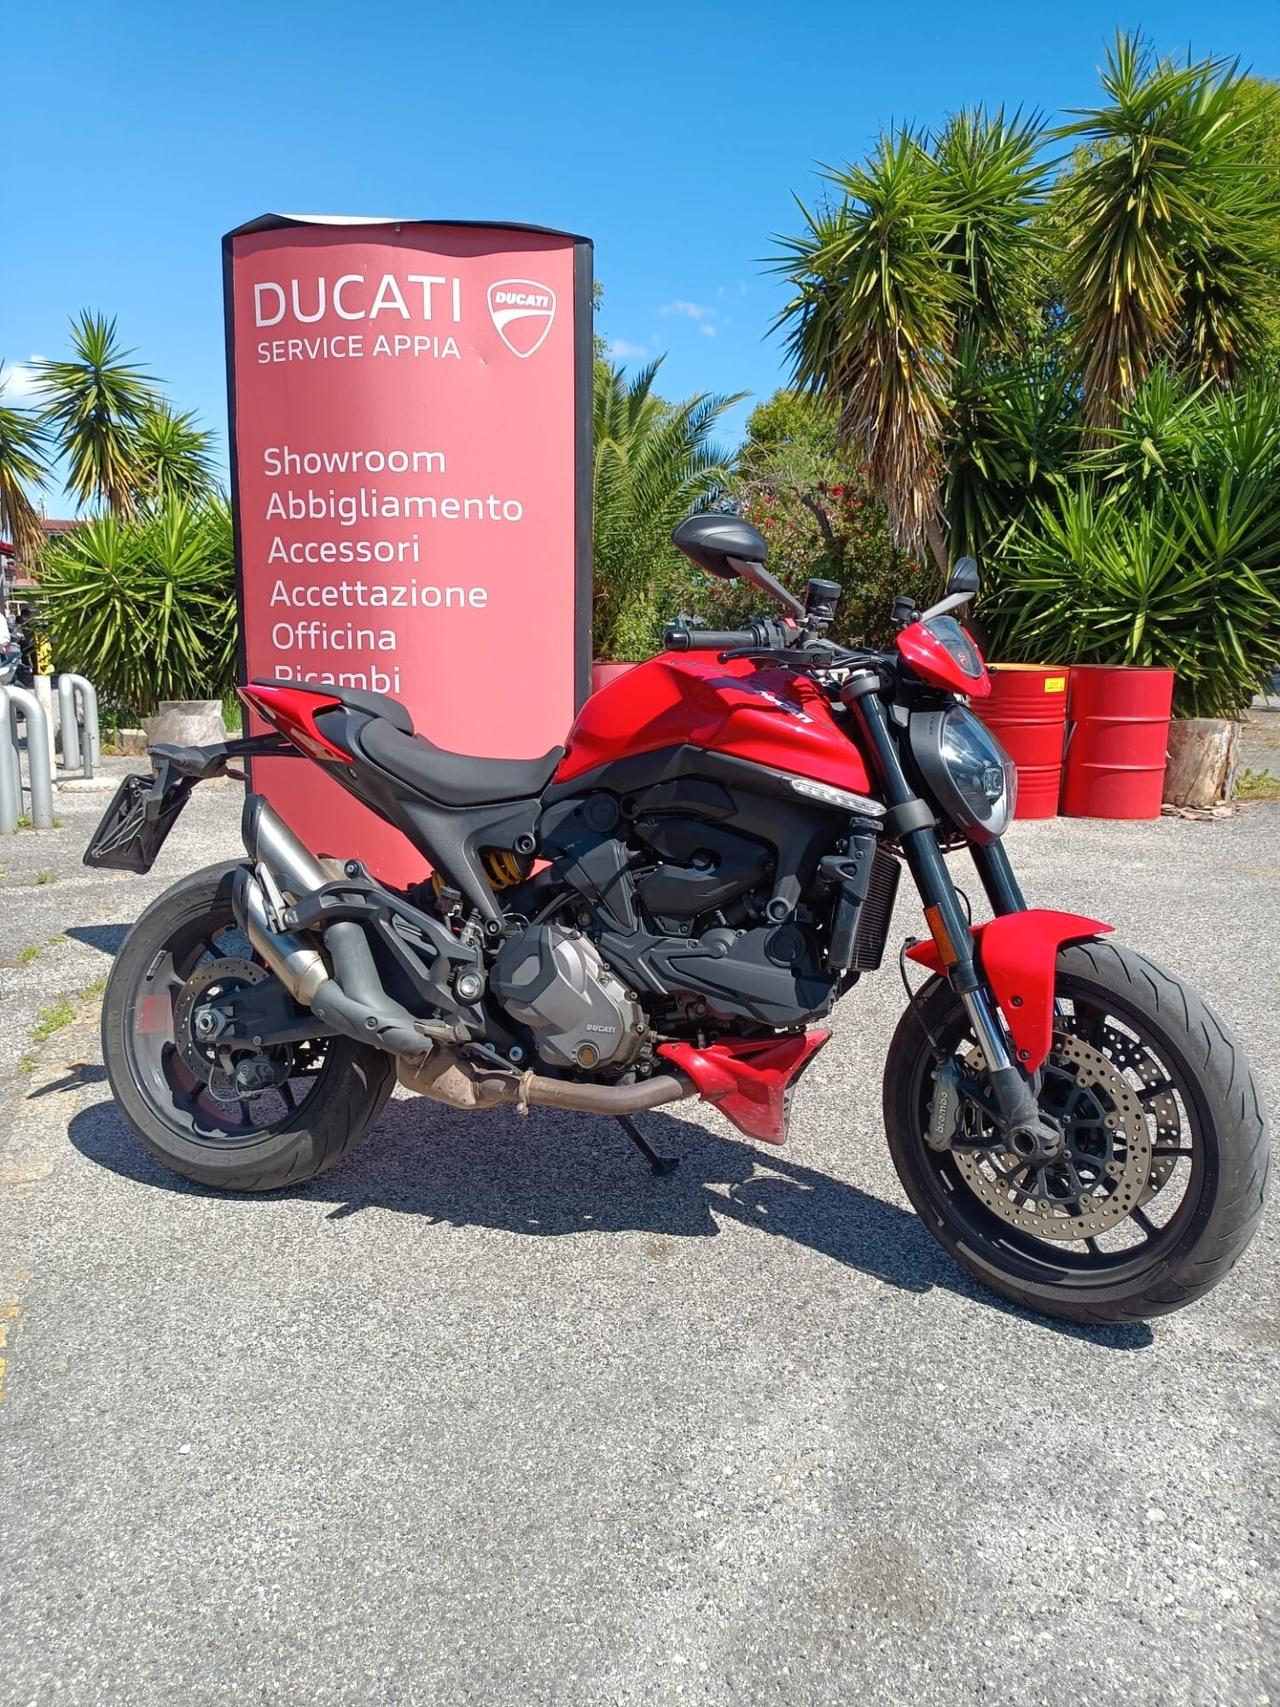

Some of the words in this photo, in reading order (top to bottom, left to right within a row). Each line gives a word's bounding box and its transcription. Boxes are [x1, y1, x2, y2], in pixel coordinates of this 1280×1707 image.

[254, 274, 462, 328] DUCATI
[495, 291, 549, 308] DUCATI
[258, 335, 364, 364] SERVICE
[373, 335, 462, 360] APPIA
[264, 446, 446, 477] Showroom
[266, 488, 524, 526] Abbigliamento
[268, 535, 420, 564] Accessori
[270, 579, 488, 608] Accettazione
[272, 621, 397, 651] Officina
[586, 1023, 616, 1034] DUCATI
[935, 1091, 948, 1134] brembo
